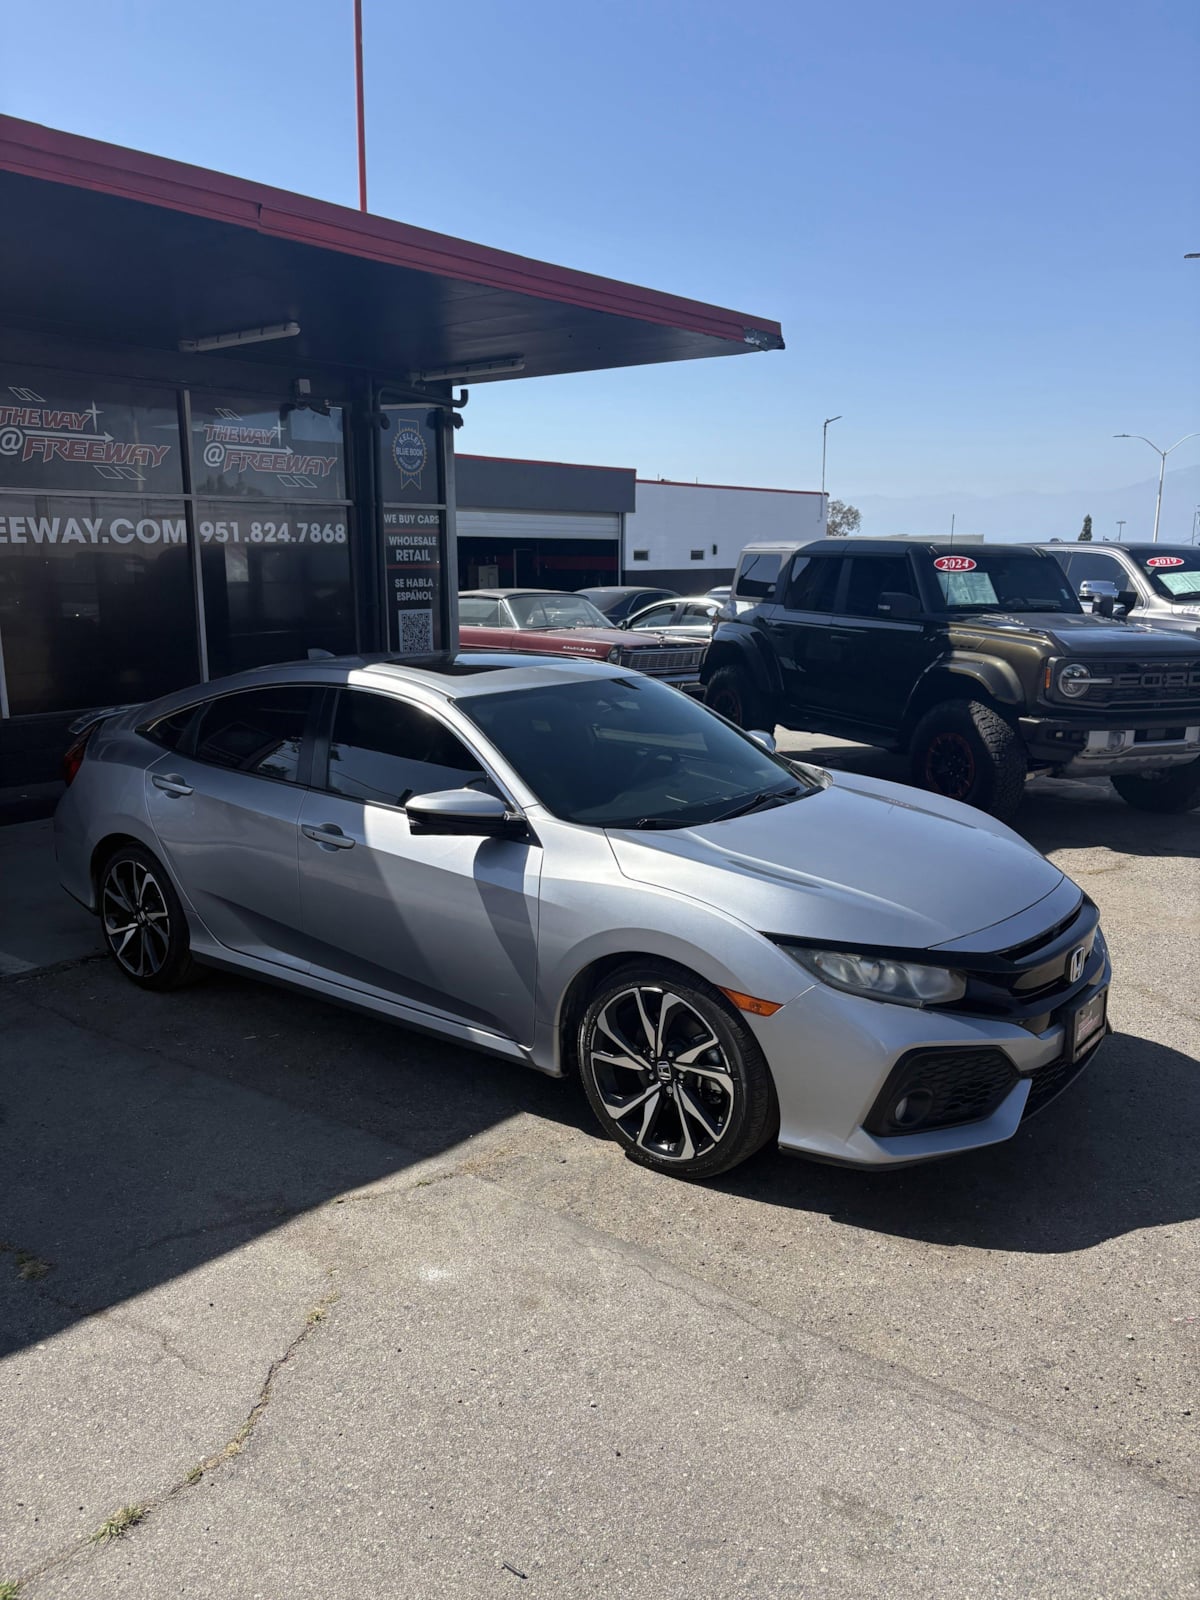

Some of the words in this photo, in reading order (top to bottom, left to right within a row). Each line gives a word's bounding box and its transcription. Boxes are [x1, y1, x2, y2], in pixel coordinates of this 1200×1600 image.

[399, 432, 421, 446] KELLEY
[395, 446, 410, 456] BLUE
[410, 447, 424, 457] BOOK
[383, 513, 397, 524] WE
[398, 514, 415, 524] BUY
[417, 514, 440, 525] CARS
[200, 521, 346, 544] 951.824.7868
[388, 535, 437, 546] WHOLESALE
[395, 549, 431, 562] RETAIL
[942, 558, 970, 570] 2024
[1154, 557, 1178, 567] 2019
[394, 578, 405, 588] SE
[406, 577, 434, 588] HABLA
